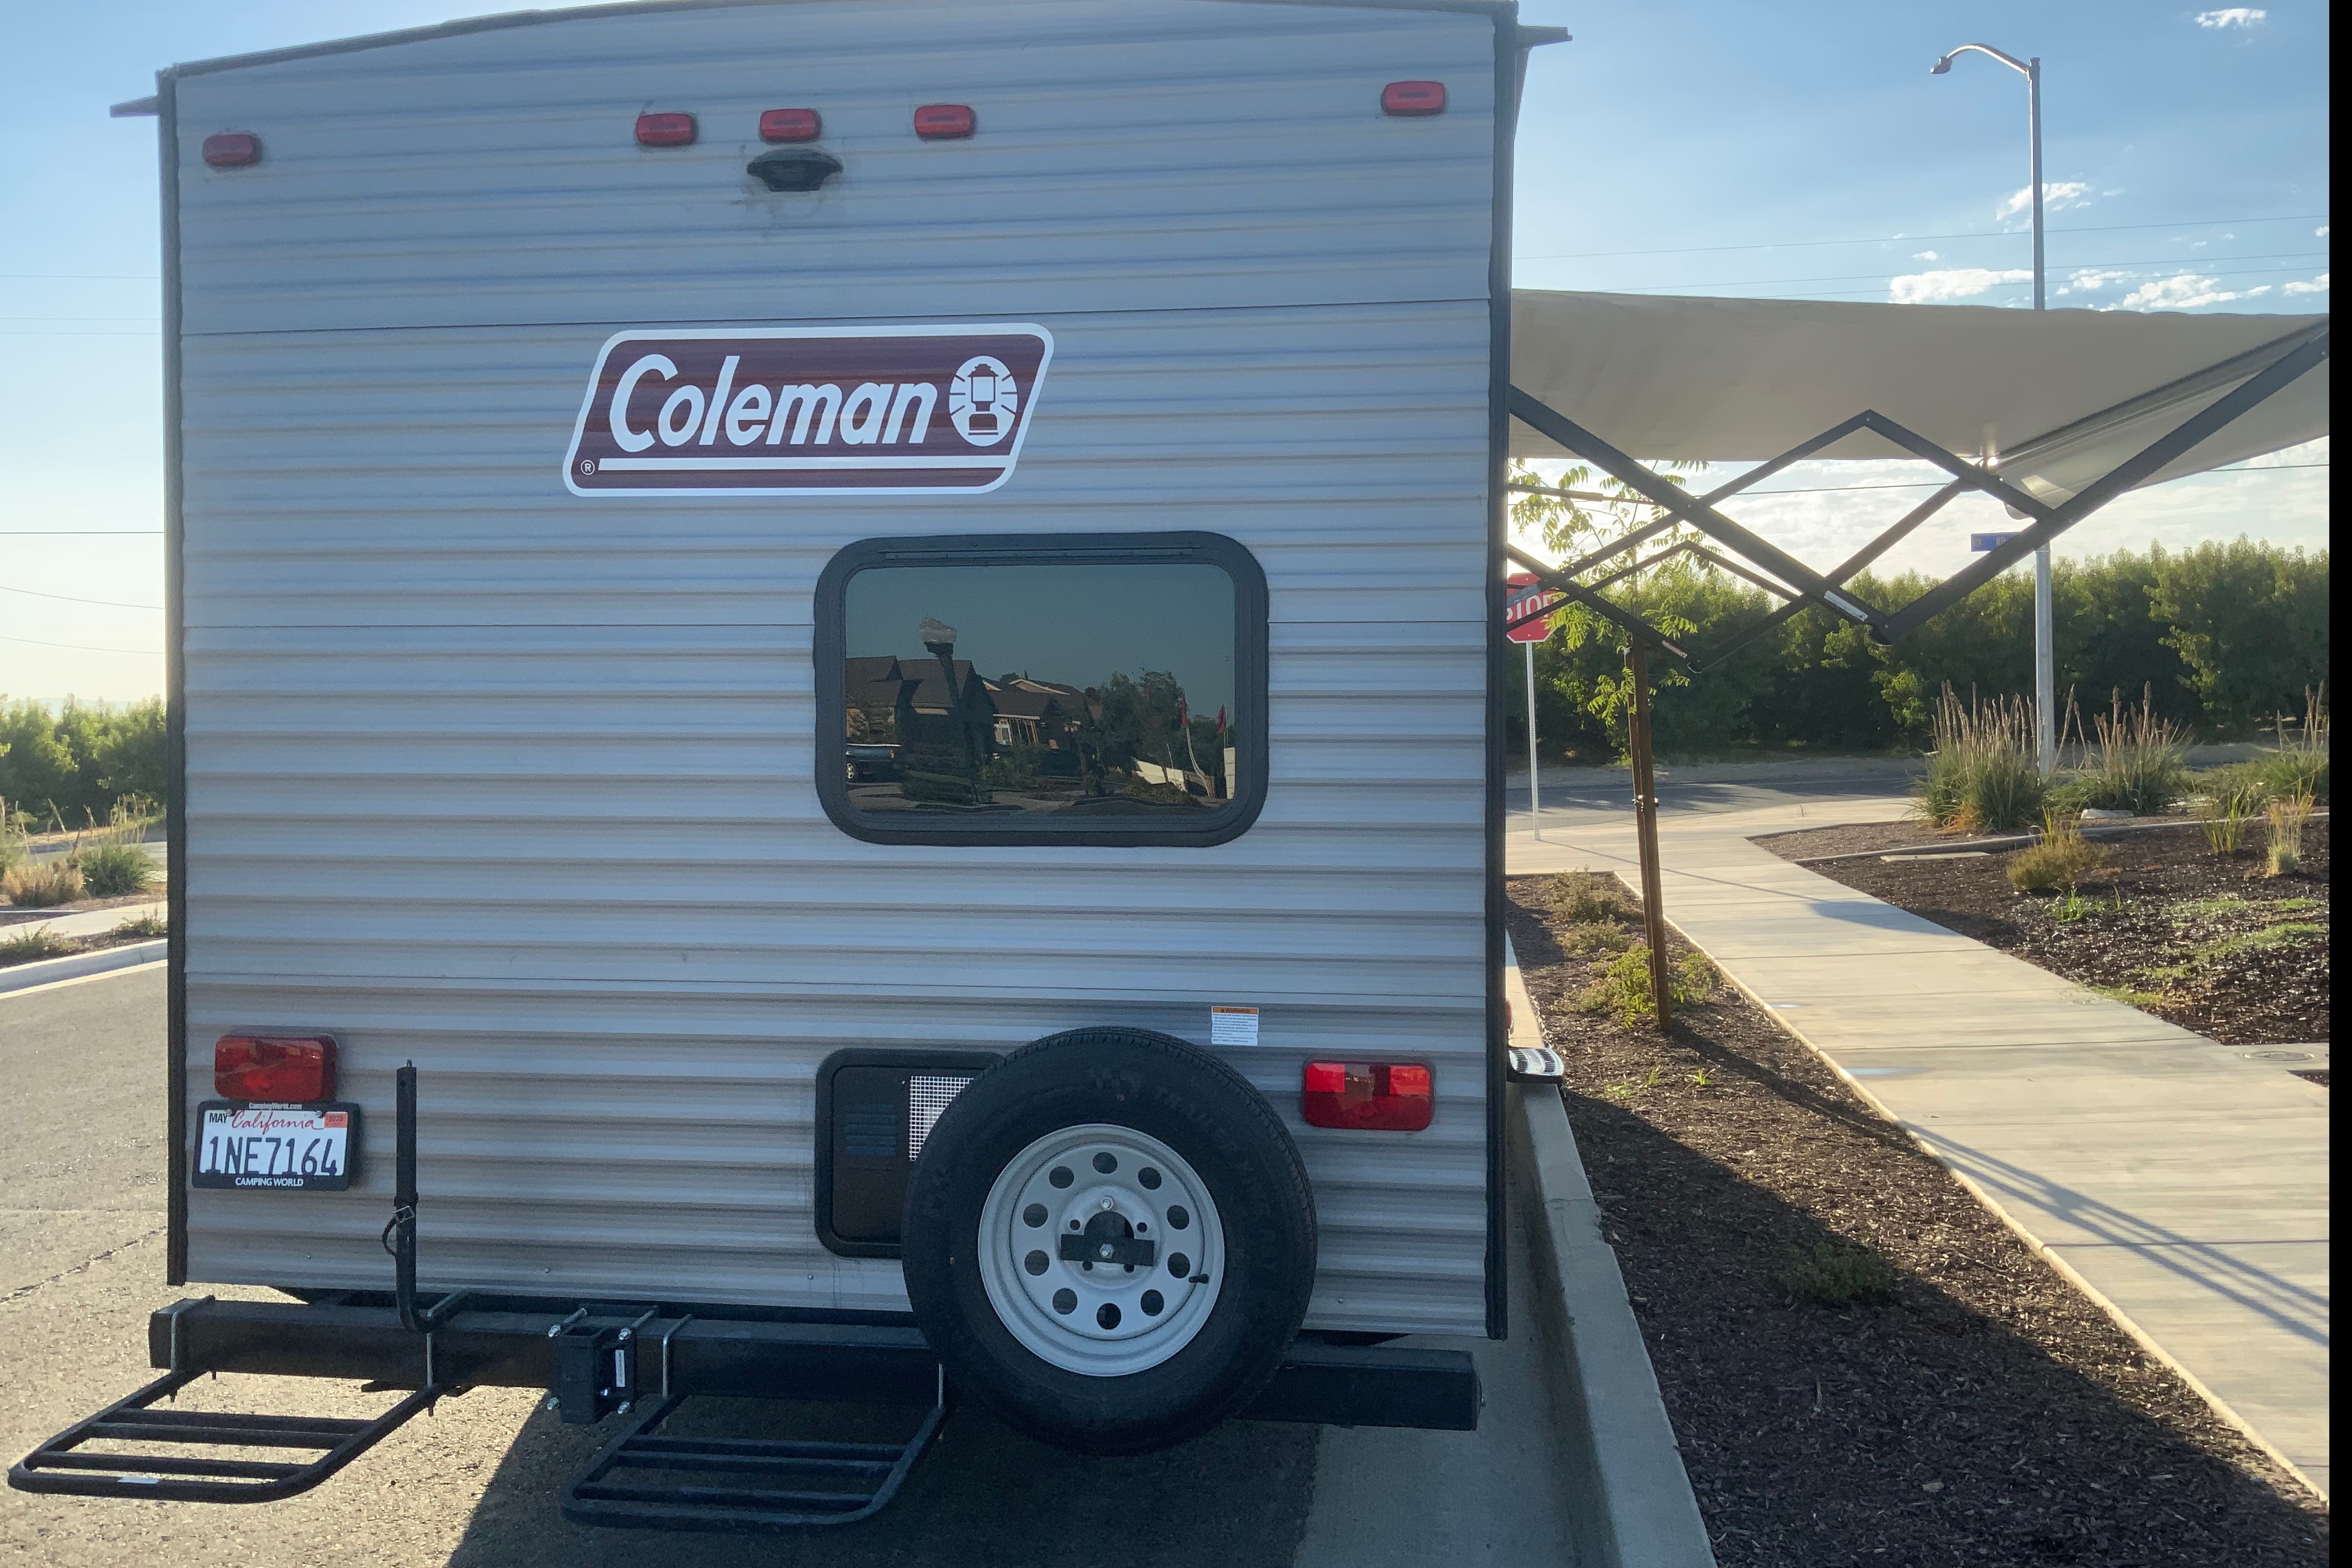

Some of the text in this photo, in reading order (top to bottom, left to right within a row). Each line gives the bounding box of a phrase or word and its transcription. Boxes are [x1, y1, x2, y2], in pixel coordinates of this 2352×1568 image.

[608, 354, 939, 453] Coleman
[209, 1112, 229, 1124] MAY
[232, 1110, 324, 1135] California
[205, 1136, 337, 1176] 1NE7164
[235, 1177, 304, 1186] CAMPING WORLD
